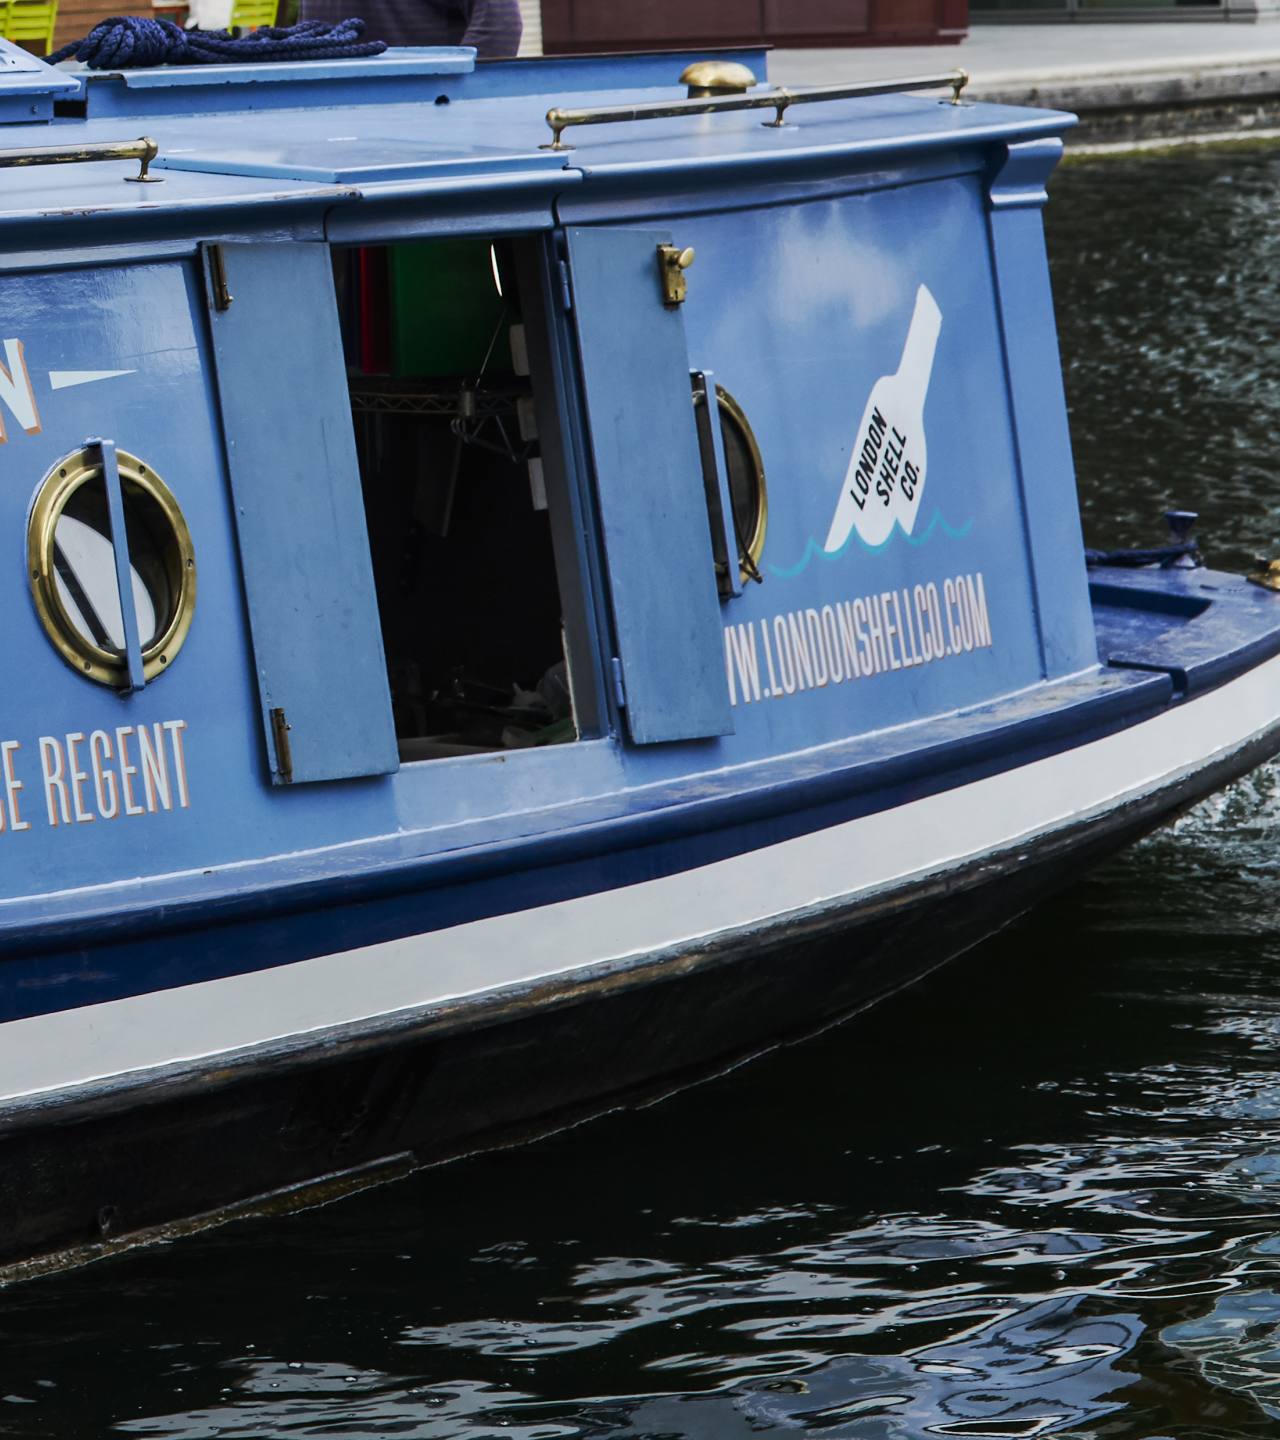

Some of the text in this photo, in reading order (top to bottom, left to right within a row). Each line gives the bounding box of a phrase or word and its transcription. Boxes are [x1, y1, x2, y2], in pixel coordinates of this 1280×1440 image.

[850, 406, 887, 511] LONDON
[876, 426, 907, 507] SHELL
[900, 460, 920, 502] CO.
[724, 572, 993, 707] W.LONDONSHELLCO.COM
[39, 718, 192, 827] REGENT
